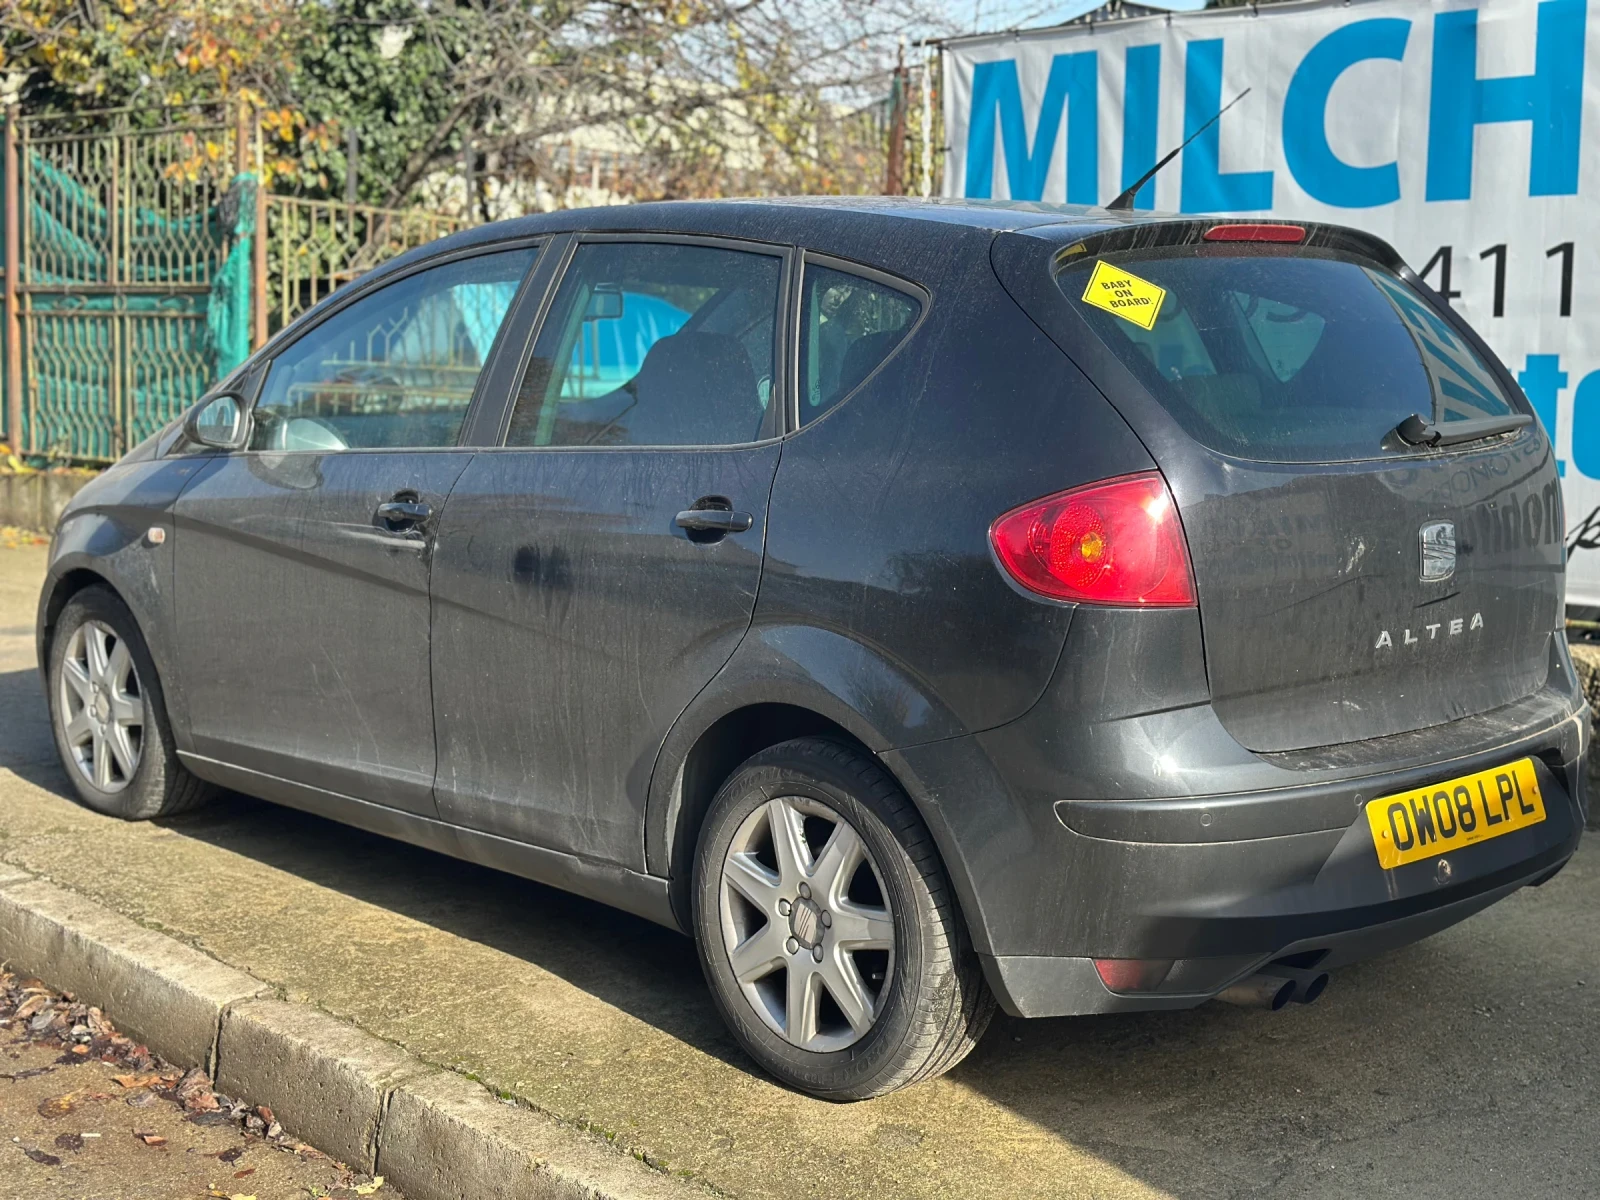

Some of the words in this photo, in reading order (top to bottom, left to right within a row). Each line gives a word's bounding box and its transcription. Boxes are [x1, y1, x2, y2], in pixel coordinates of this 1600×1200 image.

[1101, 280, 1132, 290] BABY
[1114, 290, 1133, 298] ON
[1109, 297, 1154, 308] BOARD!
[1375, 612, 1484, 649] ALTEA
[1387, 785, 1477, 851] OW08
[1477, 770, 1535, 827] LPL
